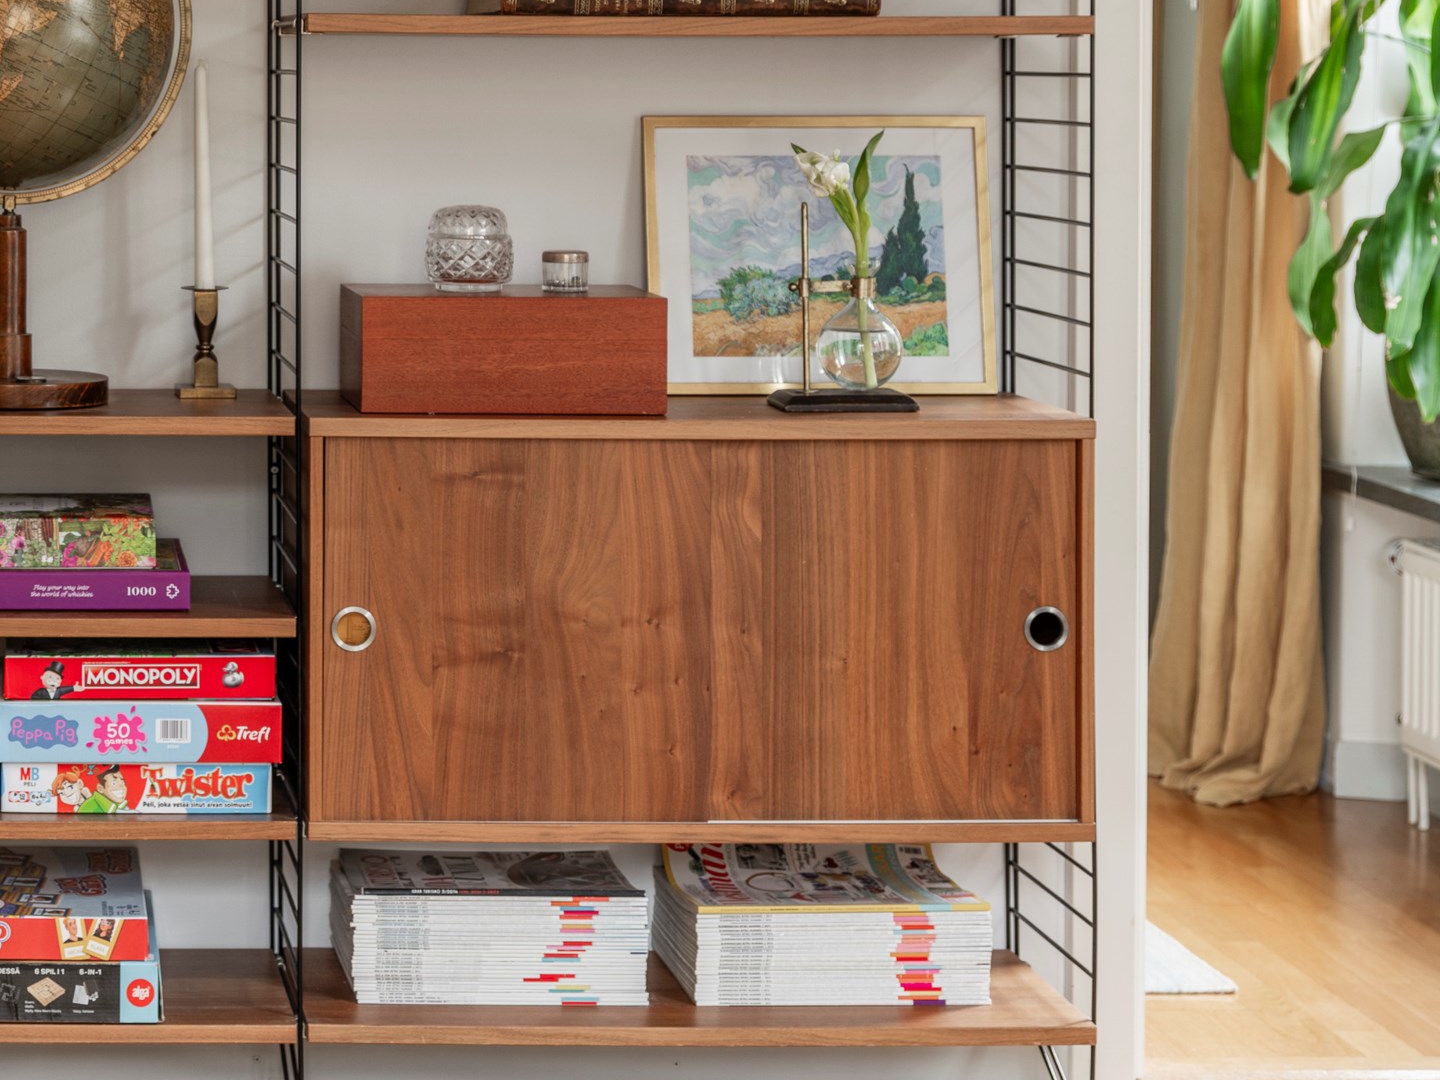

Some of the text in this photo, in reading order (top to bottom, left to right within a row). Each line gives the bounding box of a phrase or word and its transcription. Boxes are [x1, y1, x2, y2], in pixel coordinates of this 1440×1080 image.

[127, 587, 156, 596] 1000
[86, 668, 197, 686] MONOPOLY
[11, 719, 76, 744] Peppa Pig
[106, 723, 131, 738] 50
[236, 725, 271, 743] Trefl
[104, 739, 134, 747] games
[21, 768, 39, 780] MB
[141, 768, 254, 799] Twister
[132, 986, 150, 1000] alga
